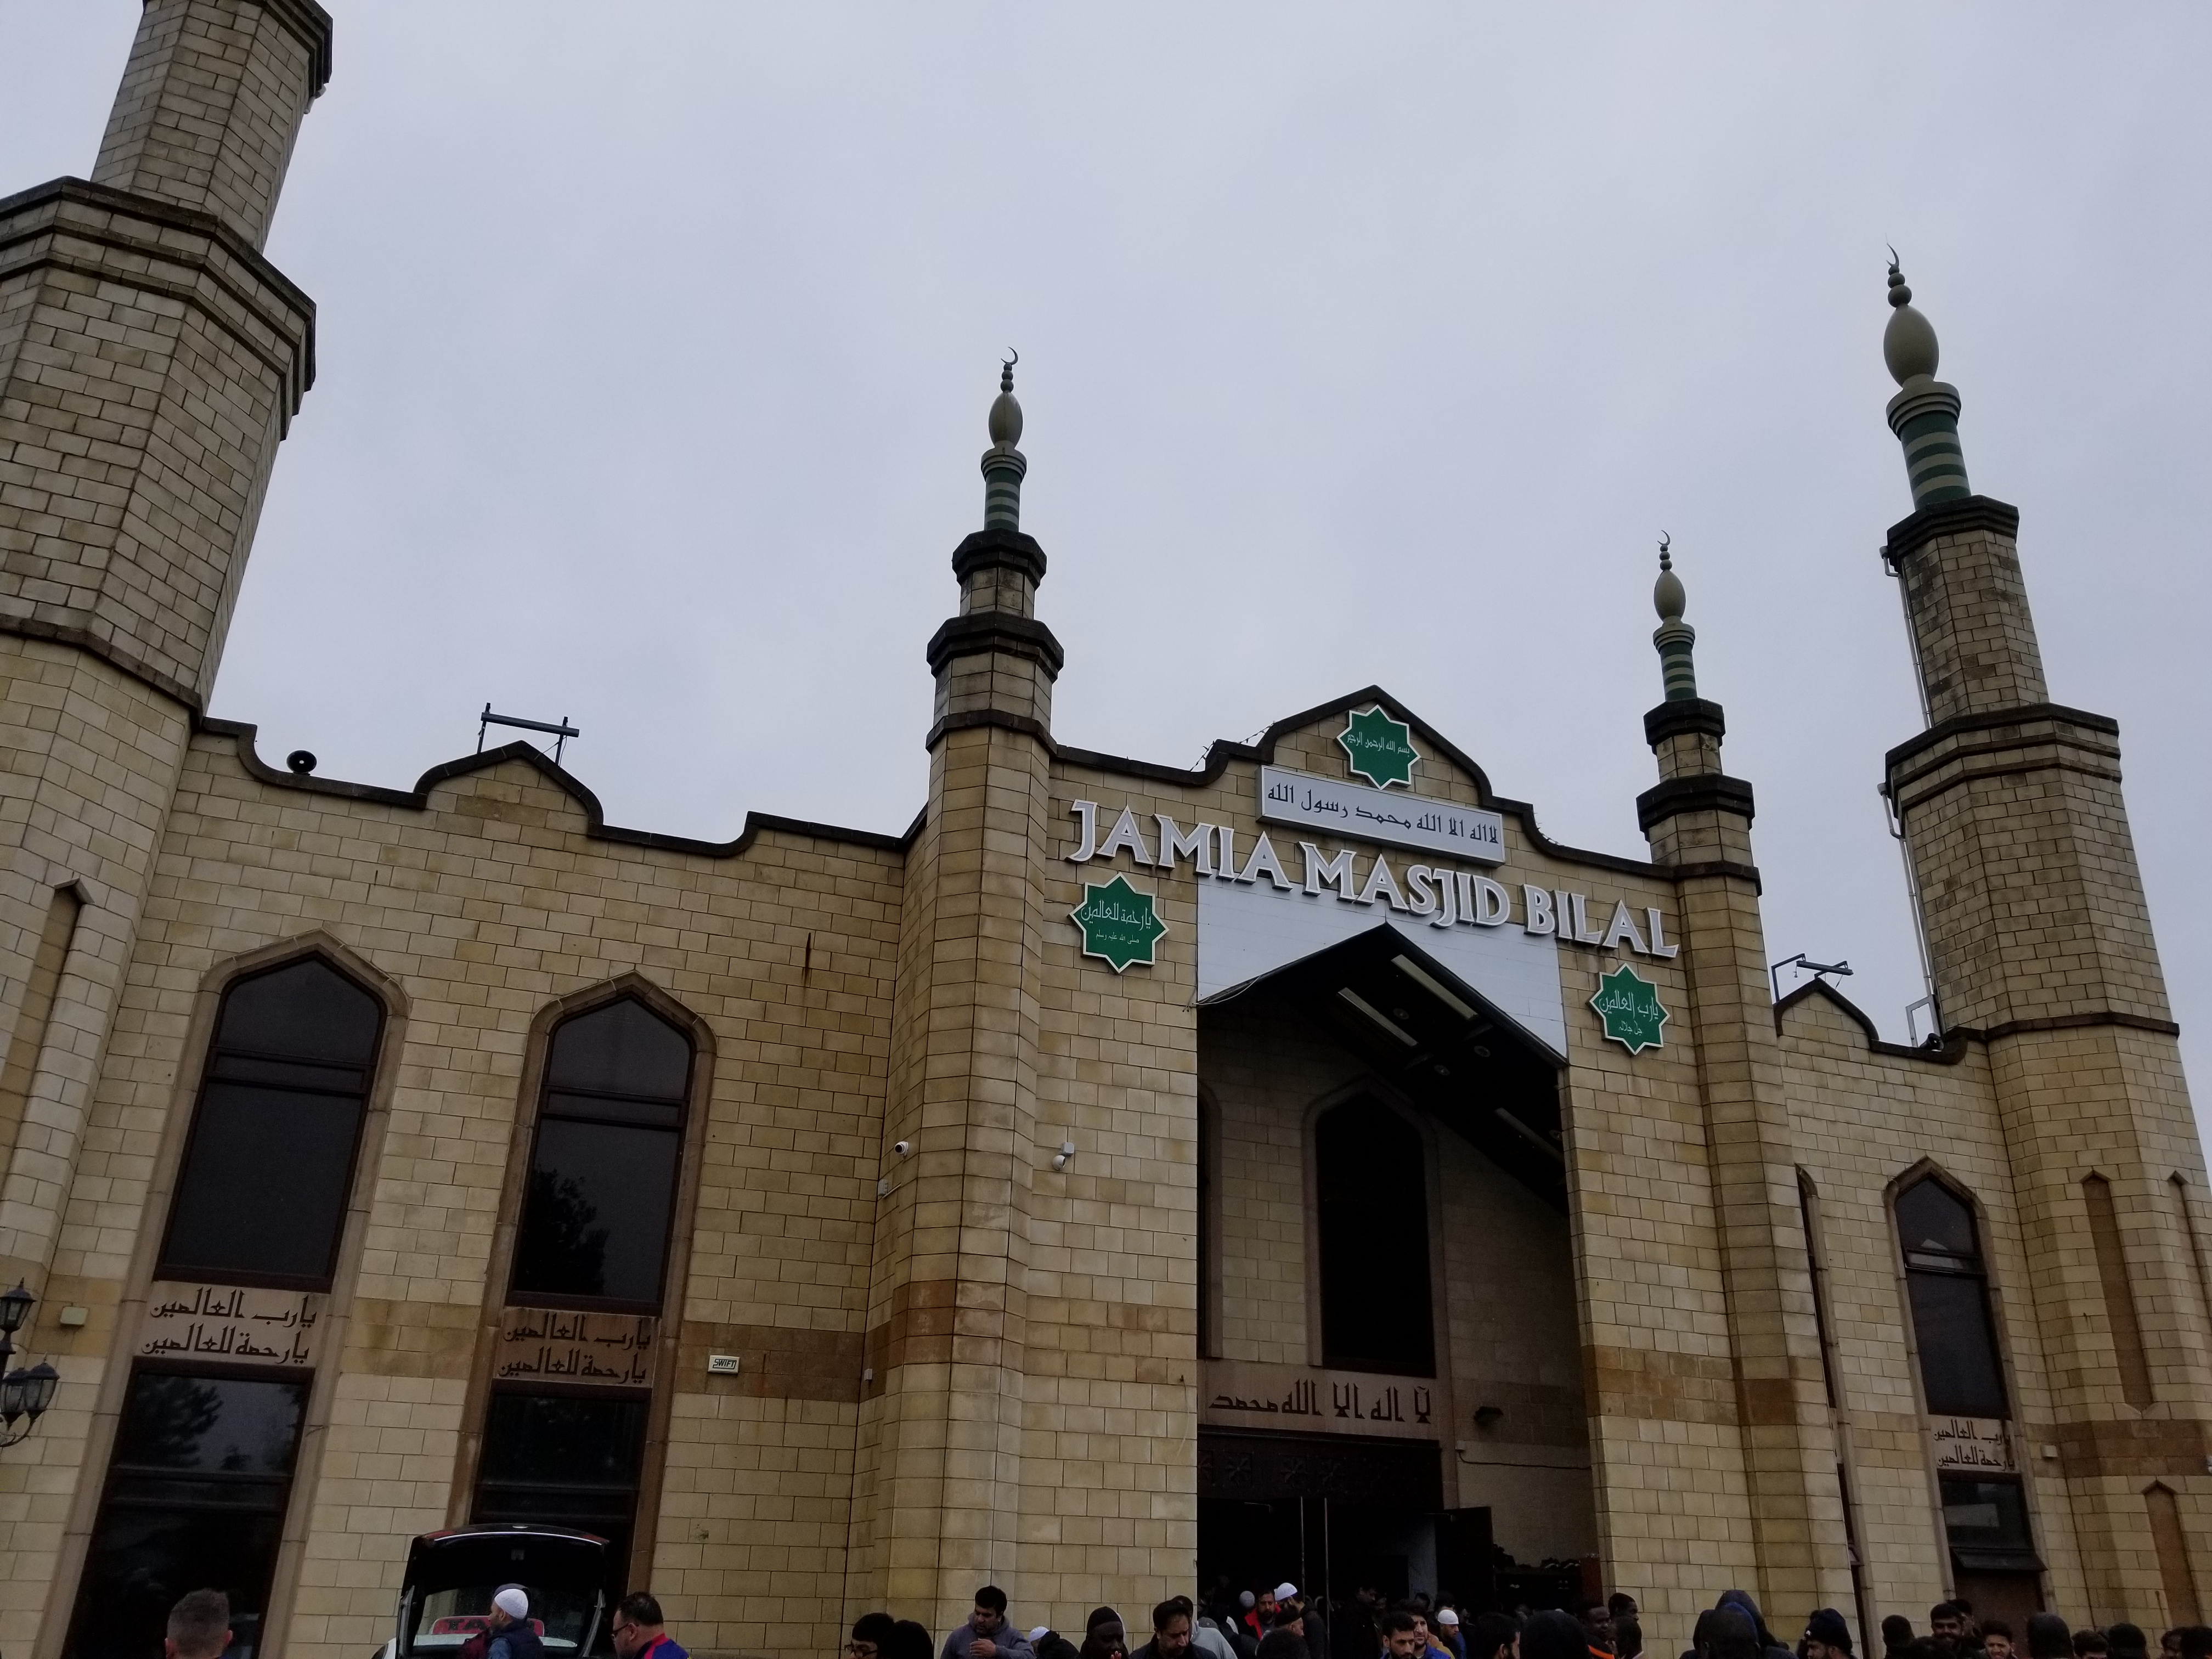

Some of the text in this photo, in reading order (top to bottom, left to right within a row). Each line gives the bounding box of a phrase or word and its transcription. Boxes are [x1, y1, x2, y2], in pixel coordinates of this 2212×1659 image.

[1347, 731, 1410, 758] بسم الله الرحمن الرحيم
[1267, 782, 1294, 804] الله
[1301, 789, 1348, 818] رسول
[1355, 806, 1412, 830] محمد
[1417, 812, 1442, 833] الله
[1065, 799, 1680, 960] JAMIA MASJID BILAL
[713, 1358, 737, 1370] SWIFT
[1208, 1394, 1279, 1413] محمد
[1281, 1378, 1324, 1417] الله
